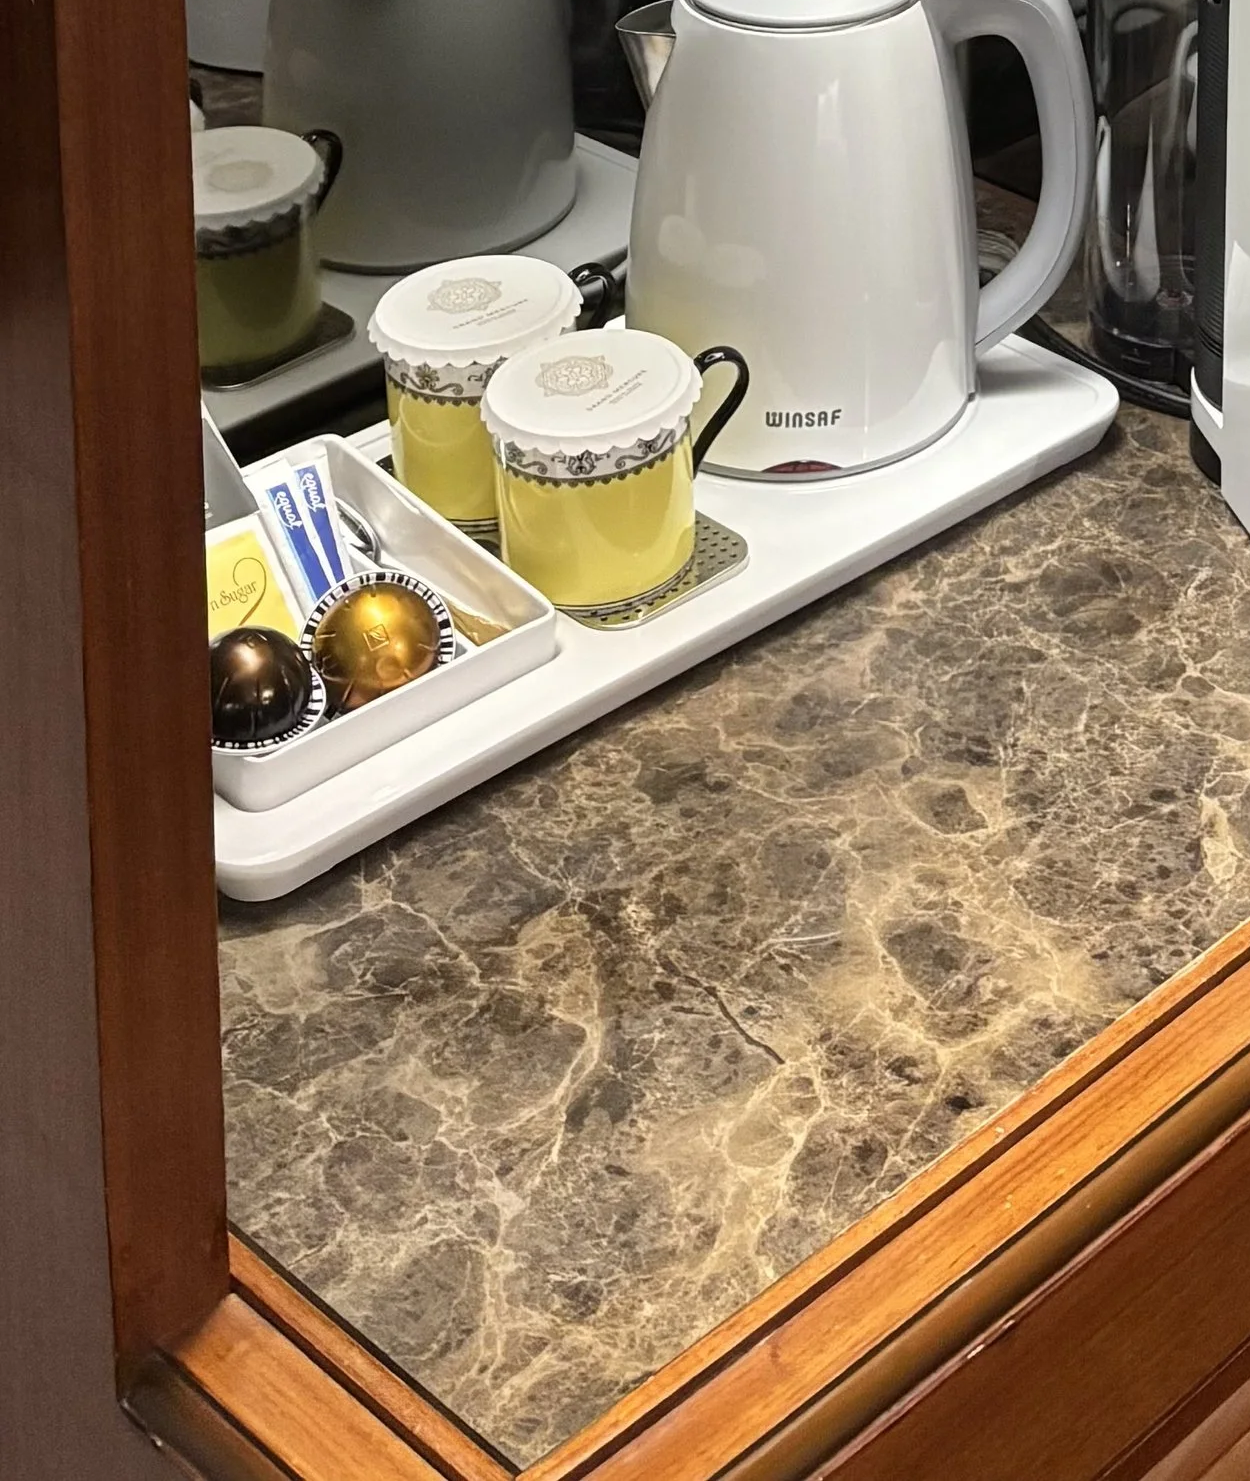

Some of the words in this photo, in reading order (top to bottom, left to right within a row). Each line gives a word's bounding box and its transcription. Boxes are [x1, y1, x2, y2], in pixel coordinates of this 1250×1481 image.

[765, 408, 842, 428] WINSAF
[300, 472, 328, 513] equal
[273, 490, 304, 530] equal
[220, 580, 257, 606] Sugar
